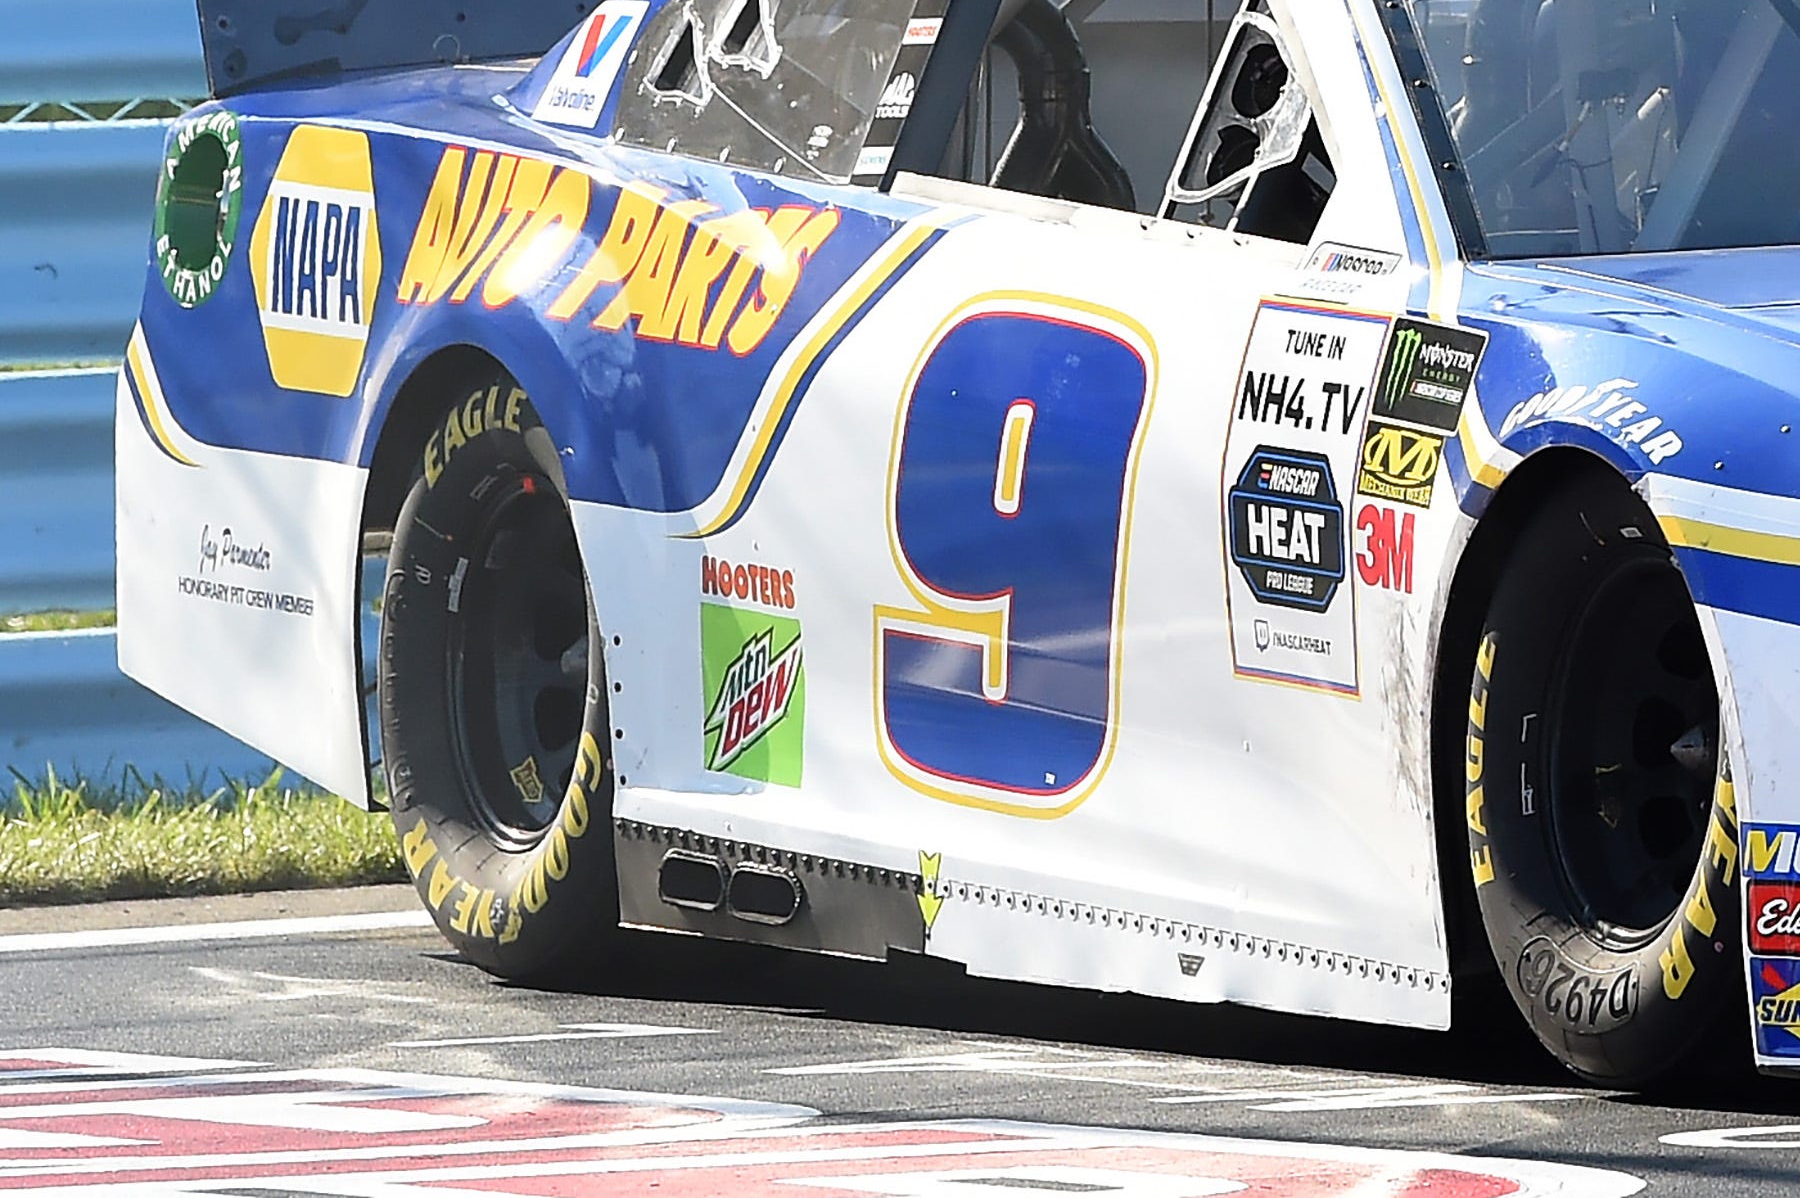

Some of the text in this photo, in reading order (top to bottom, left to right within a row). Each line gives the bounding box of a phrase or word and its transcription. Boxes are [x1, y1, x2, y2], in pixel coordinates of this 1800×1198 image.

[874, 105, 910, 119] TOOLS
[166, 110, 242, 199] AMERICAN
[159, 232, 232, 310] ETHANOL
[270, 196, 363, 325] NAPA
[396, 144, 843, 357] AUTO PARTS
[1285, 329, 1347, 361] TUNE IN
[1419, 342, 1475, 373] MONSTER
[423, 384, 529, 491] EAGLE
[1238, 370, 1366, 436] NH4.TV
[875, 292, 1158, 818] 9
[1247, 503, 1326, 565] HEAT
[1355, 503, 1416, 595] 3M
[178, 576, 230, 603] HONORARY
[230, 586, 246, 605] PIT
[245, 589, 274, 610] CREW
[702, 555, 796, 610] HOOTERS
[1465, 631, 1498, 888] EAGLE
